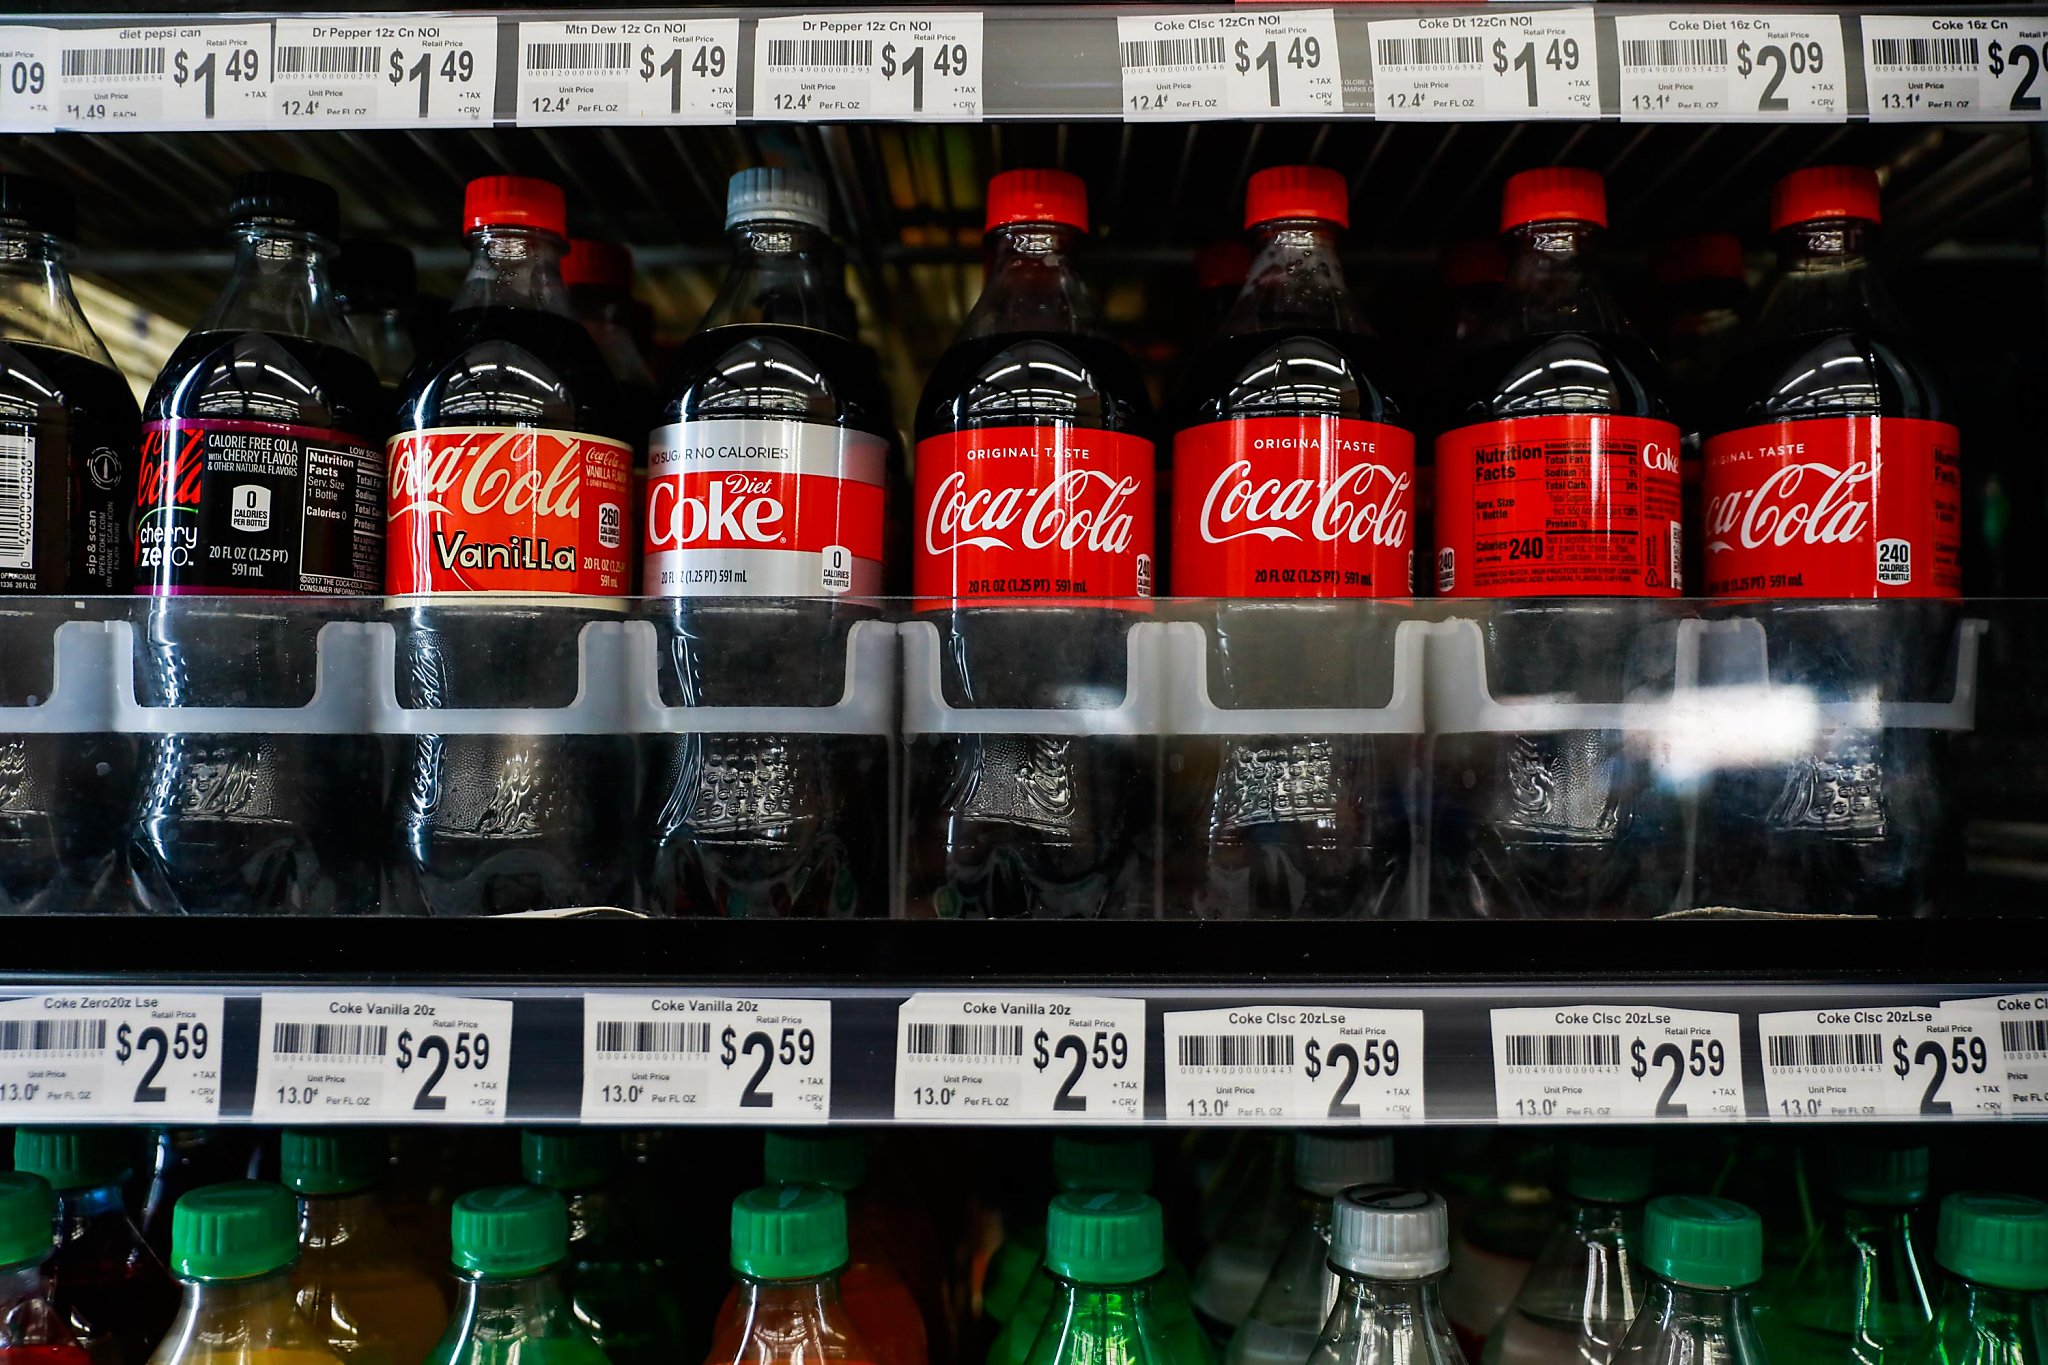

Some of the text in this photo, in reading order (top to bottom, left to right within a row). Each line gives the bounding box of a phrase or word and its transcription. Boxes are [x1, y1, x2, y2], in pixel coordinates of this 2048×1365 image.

[566, 24, 686, 34] Mtn Dew 12z Cn NOI
[803, 22, 931, 32] Dr Pepper 12z Cn NOI
[1155, 15, 1280, 31] Coke Clsc 12zCn NOI
[1419, 17, 1532, 28] Coke Dt 12zCn NOI
[1669, 20, 1770, 30] Coke Diet 16z Cn
[1933, 20, 2008, 30] Coke 16z Cn
[119, 28, 201, 40] diet pepsi can
[313, 28, 440, 38] Dr Pepper 12z Cn NOI
[209, 435, 298, 453] CALORIE FREE COLA
[1335, 440, 1375, 453] TASTE
[1760, 444, 1805, 457] TASTE
[223, 450, 298, 466] CHERRY FLAVOR
[310, 452, 354, 467] Nutrition
[696, 448, 714, 458] NO
[718, 447, 788, 459] CALORIES
[968, 448, 1089, 460] ORIGINAL TASTE
[1476, 446, 1542, 464] Nutrition
[1643, 443, 1678, 473] Coke
[214, 463, 297, 477] OTHER NATURAL FLAVORS
[310, 464, 338, 477] Facts
[1476, 466, 1515, 482] Facts
[725, 474, 772, 494] Diet
[247, 491, 256, 508] 0
[1200, 460, 1410, 548] Coca-Cola
[234, 510, 267, 519] CALORIES
[307, 506, 340, 518] Calories
[601, 508, 618, 526] 260
[649, 481, 783, 545] Coke
[926, 469, 1141, 555] Coca-Cola
[1509, 537, 1543, 559] 240
[1880, 544, 1908, 562] 240
[86, 557, 97, 574] sip
[833, 551, 841, 568] 0
[232, 564, 263, 577] 591 mL
[824, 570, 849, 579] CALORIES
[1879, 564, 1909, 572] CALORIES
[686, 570, 746, 584] (1.25 PT) 591 mL
[969, 581, 979, 593] 20
[981, 581, 990, 592] FL
[993, 580, 1005, 591] OZ
[44, 998, 76, 1009] Coke
[136, 998, 158, 1007] Lse
[330, 1003, 435, 1015] Coke Vanilla 20z
[652, 1000, 758, 1011] Coke Vanilla 20z
[964, 1003, 1071, 1015] Coke Vanilla 20z
[1998, 999, 2031, 1010] Coke
[1229, 1013, 1345, 1023] Coke Clsc 20zLse
[1555, 1013, 1671, 1023] Coke Clsc 20zLse
[1817, 1011, 1932, 1024] Coke Clsc 20zLse
